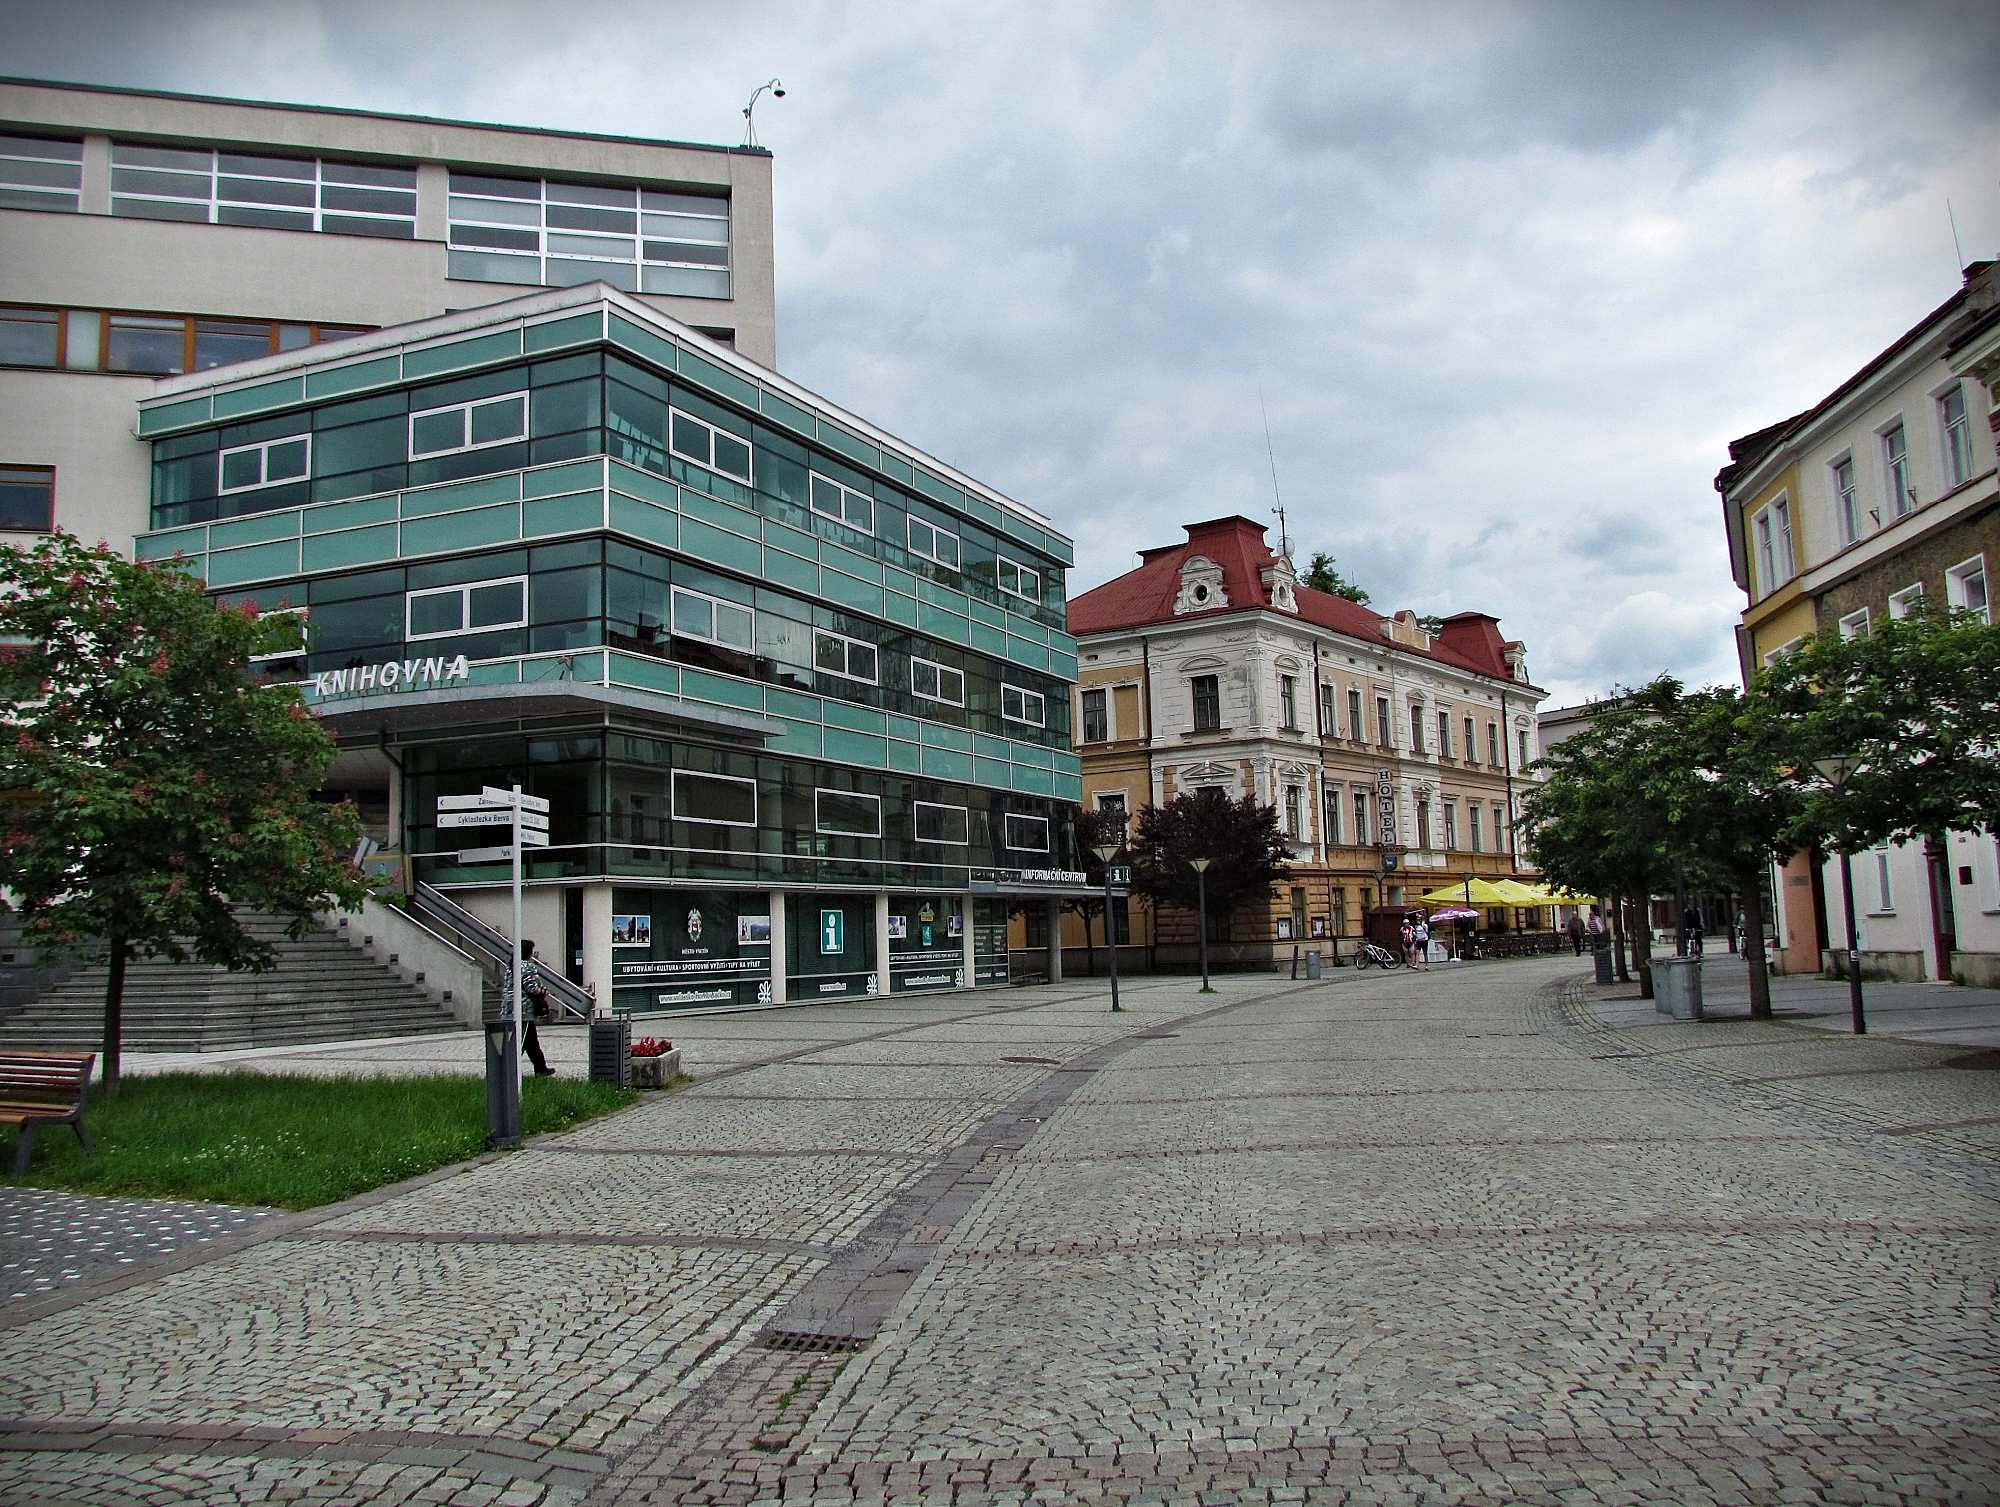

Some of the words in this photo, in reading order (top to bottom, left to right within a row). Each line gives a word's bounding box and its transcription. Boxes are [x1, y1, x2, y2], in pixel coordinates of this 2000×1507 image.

[314, 654, 470, 697] KNIHOVNA
[1378, 770, 1393, 844] HOTEL
[1024, 867, 1061, 882] INFORMAČNÍ
[1061, 871, 1087, 883] CENTRUM
[622, 963, 654, 973] UBYTOVÁNÍ
[656, 964, 679, 972] KULTURA
[682, 962, 710, 971] SPORTOVNÍ
